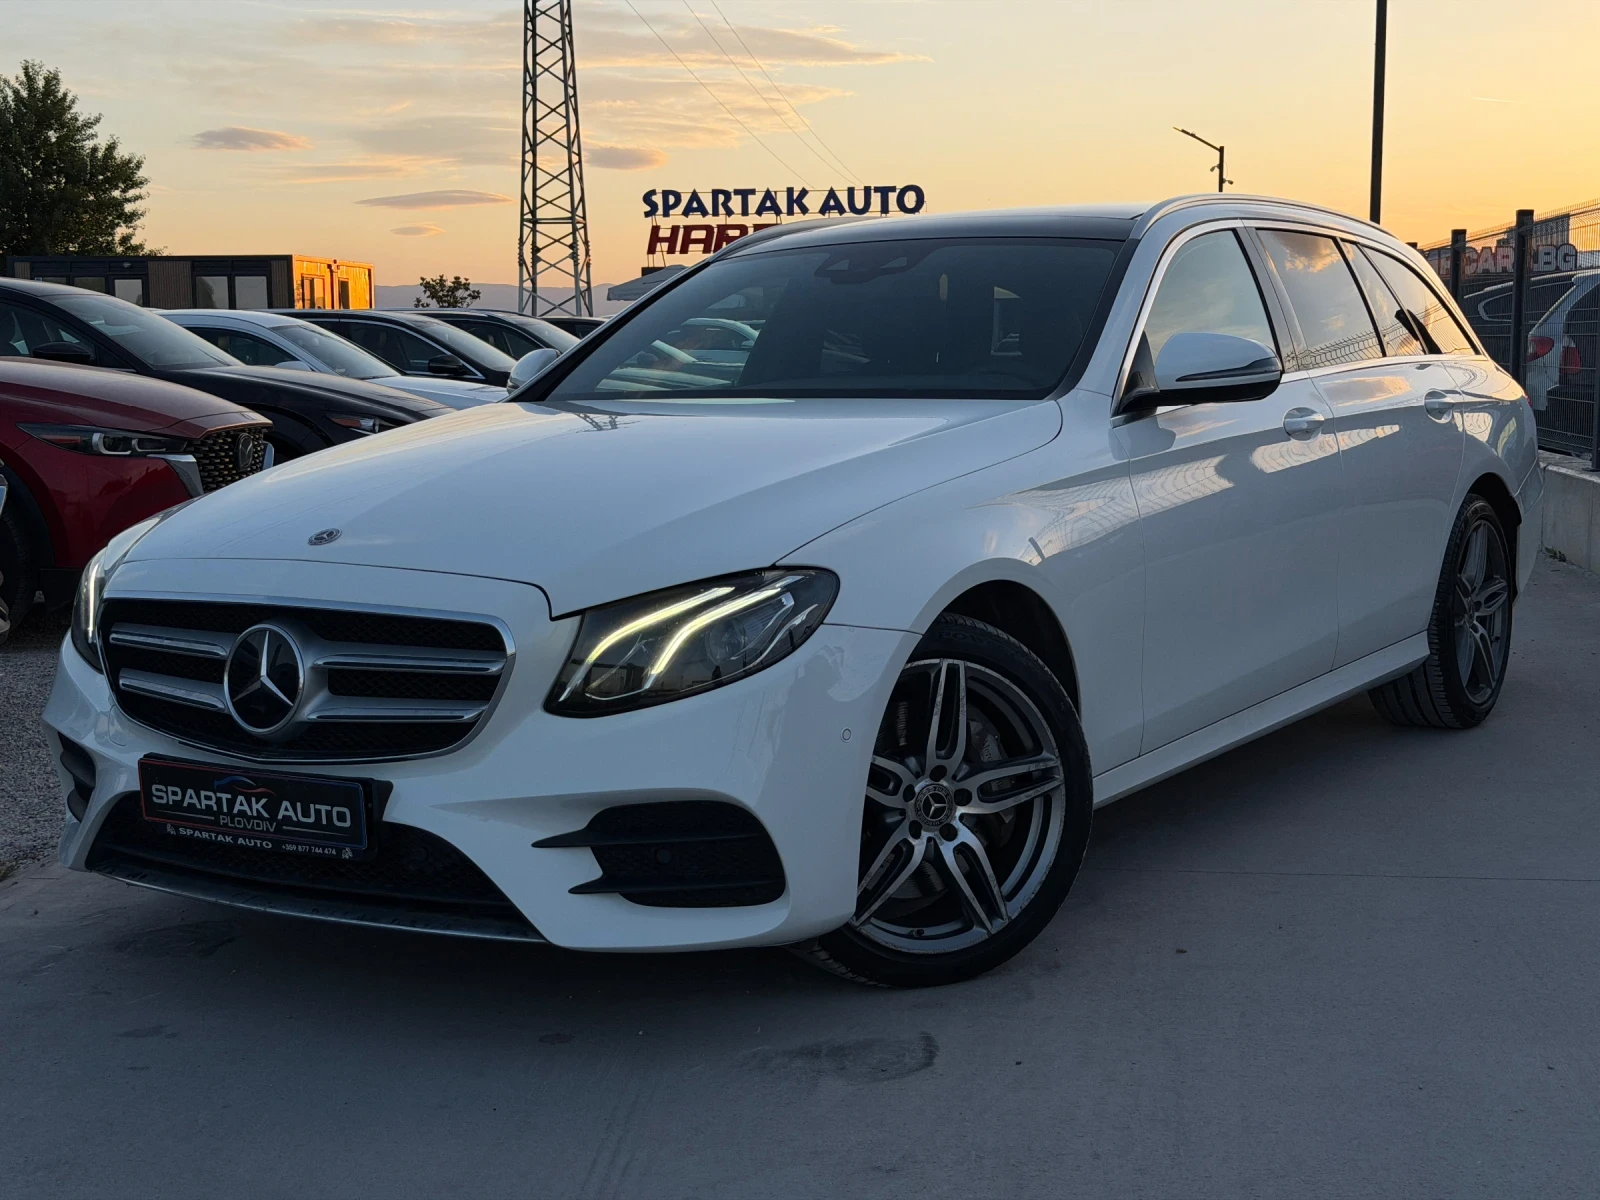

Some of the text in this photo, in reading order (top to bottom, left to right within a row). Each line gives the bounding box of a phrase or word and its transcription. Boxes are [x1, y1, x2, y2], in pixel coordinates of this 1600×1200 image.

[642, 184, 925, 219] SPARTAK AUTO
[647, 224, 780, 255] HAR
[151, 785, 352, 829] SPARTAK AUTO
[179, 828, 234, 844] SPARTAK
[237, 837, 273, 850] AUTO
[219, 814, 277, 833] PLOVDIV
